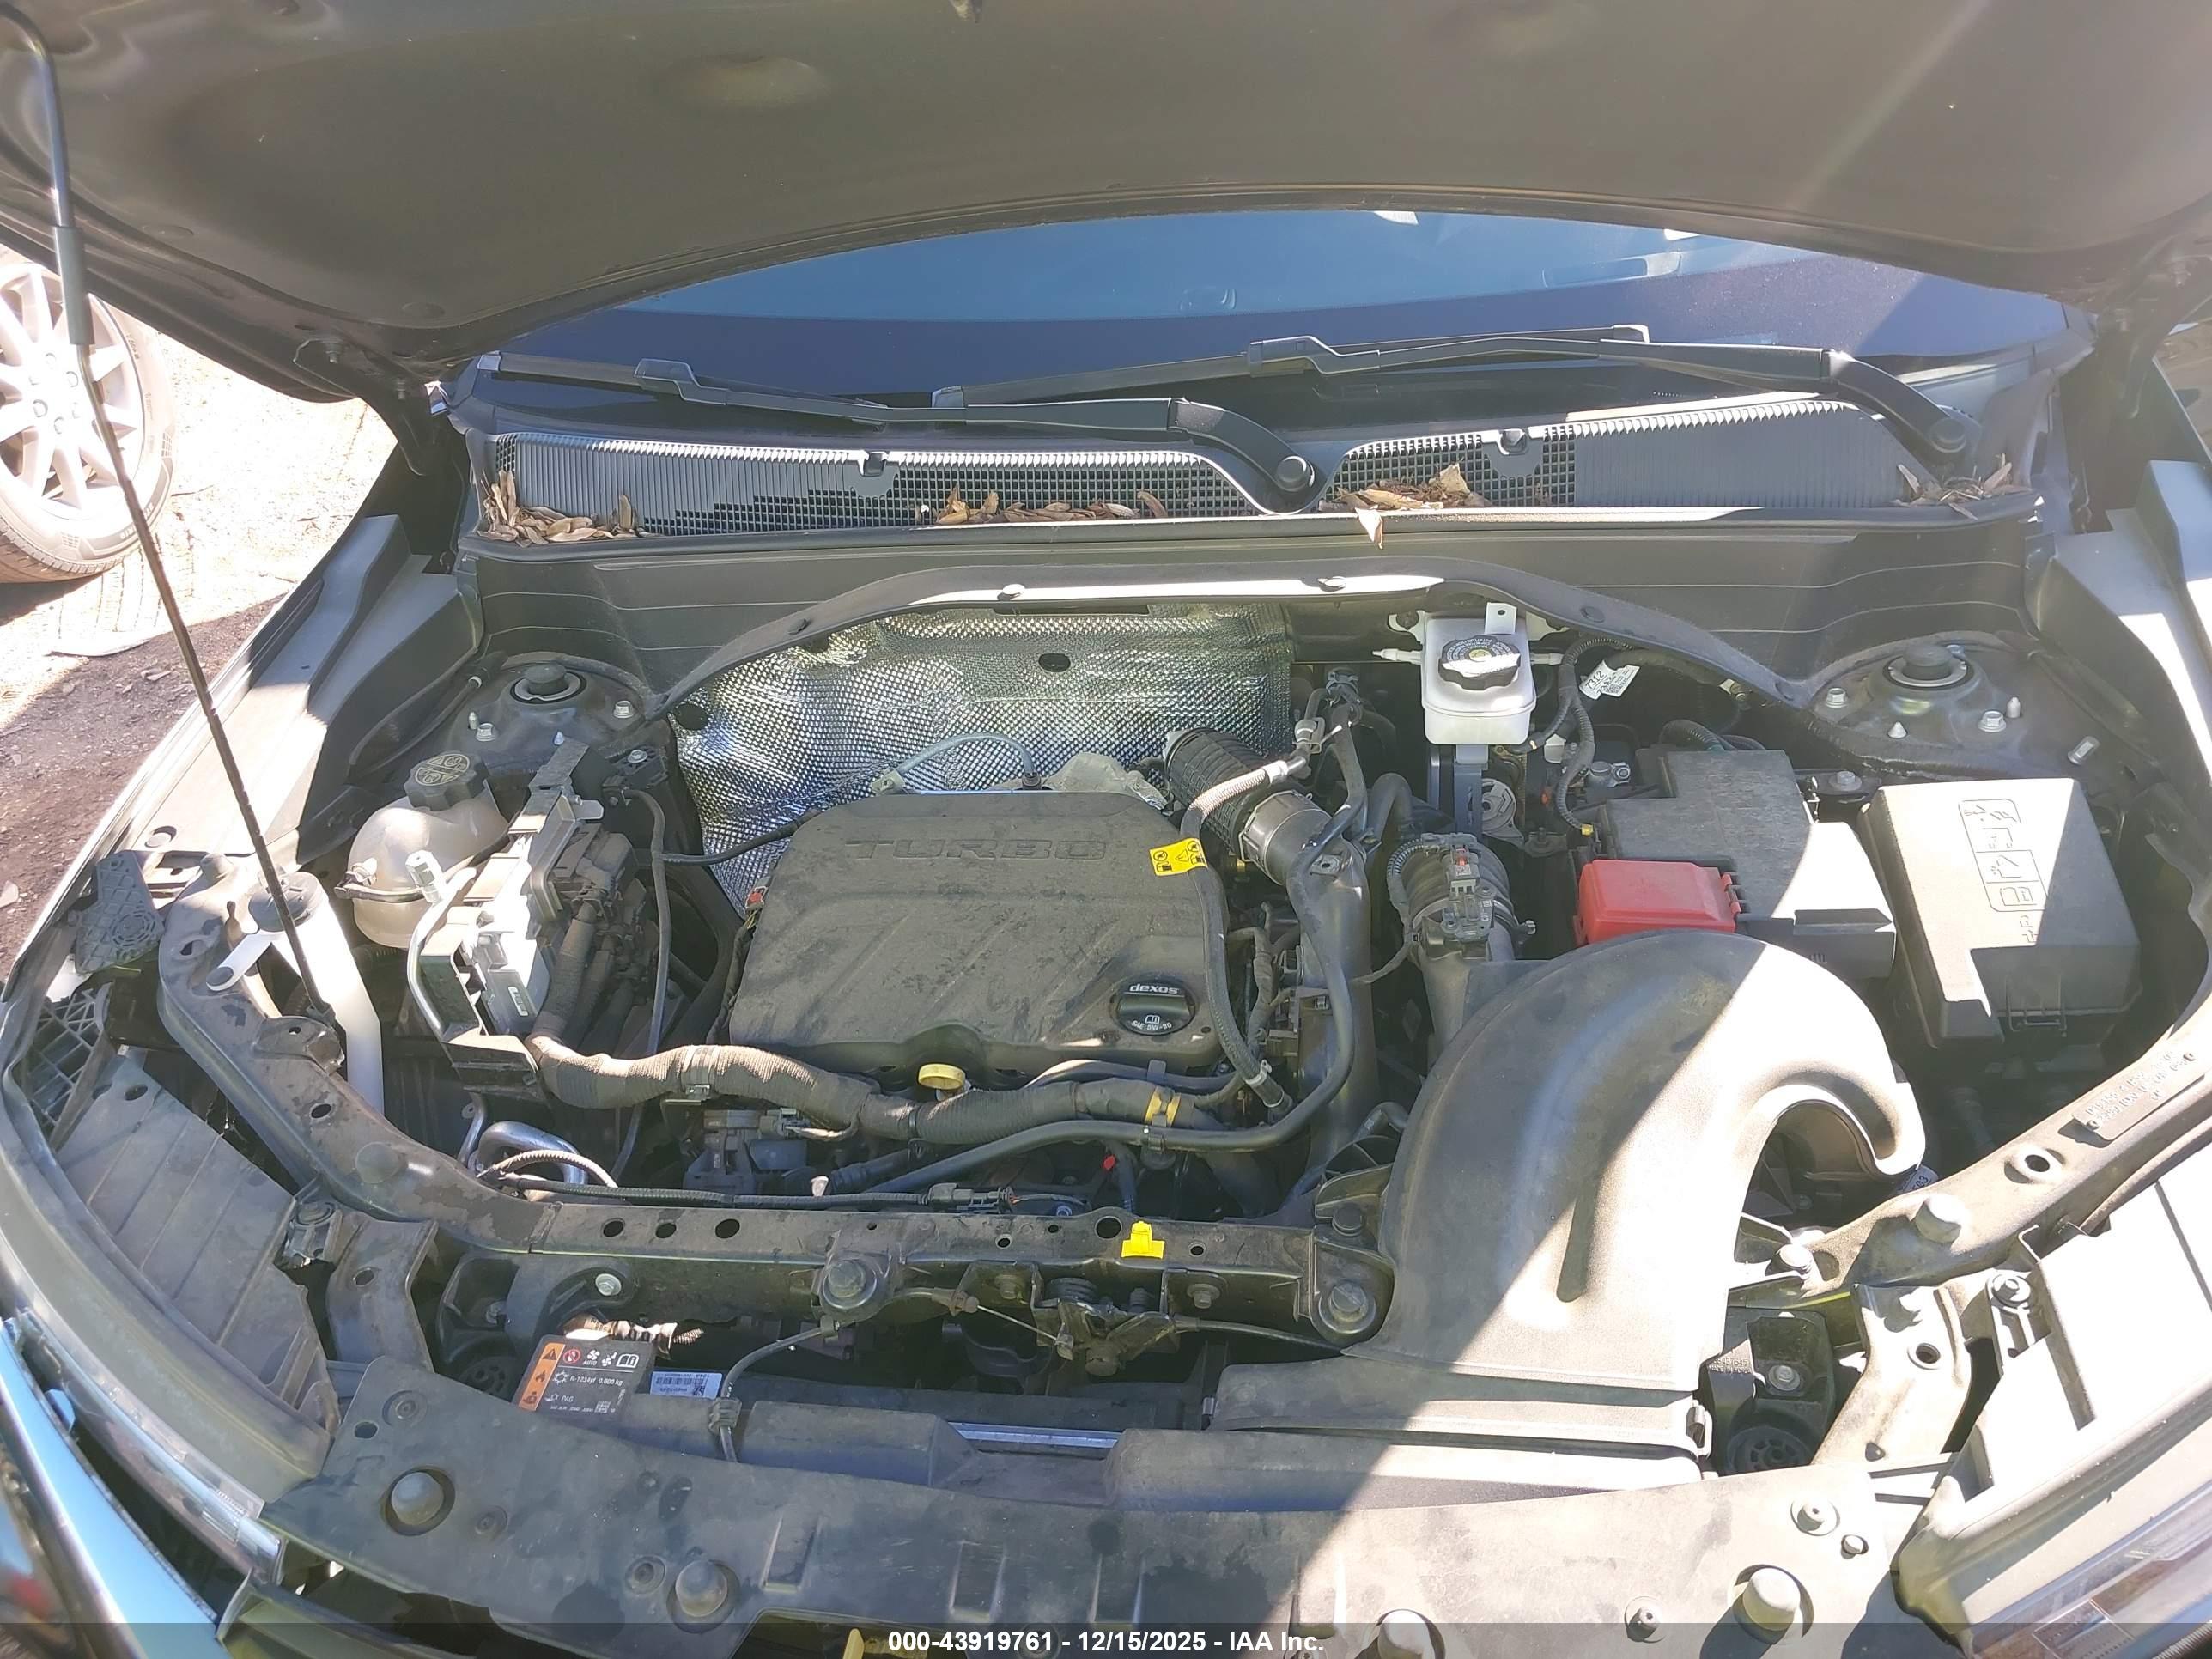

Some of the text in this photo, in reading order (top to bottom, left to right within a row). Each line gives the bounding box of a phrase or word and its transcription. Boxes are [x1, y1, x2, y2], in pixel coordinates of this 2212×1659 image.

[1585, 671, 1604, 689] 7312
[845, 839, 1107, 860] TURBO
[1129, 983, 1180, 994] dexos
[1131, 1020, 1172, 1031] SAE 5W-30
